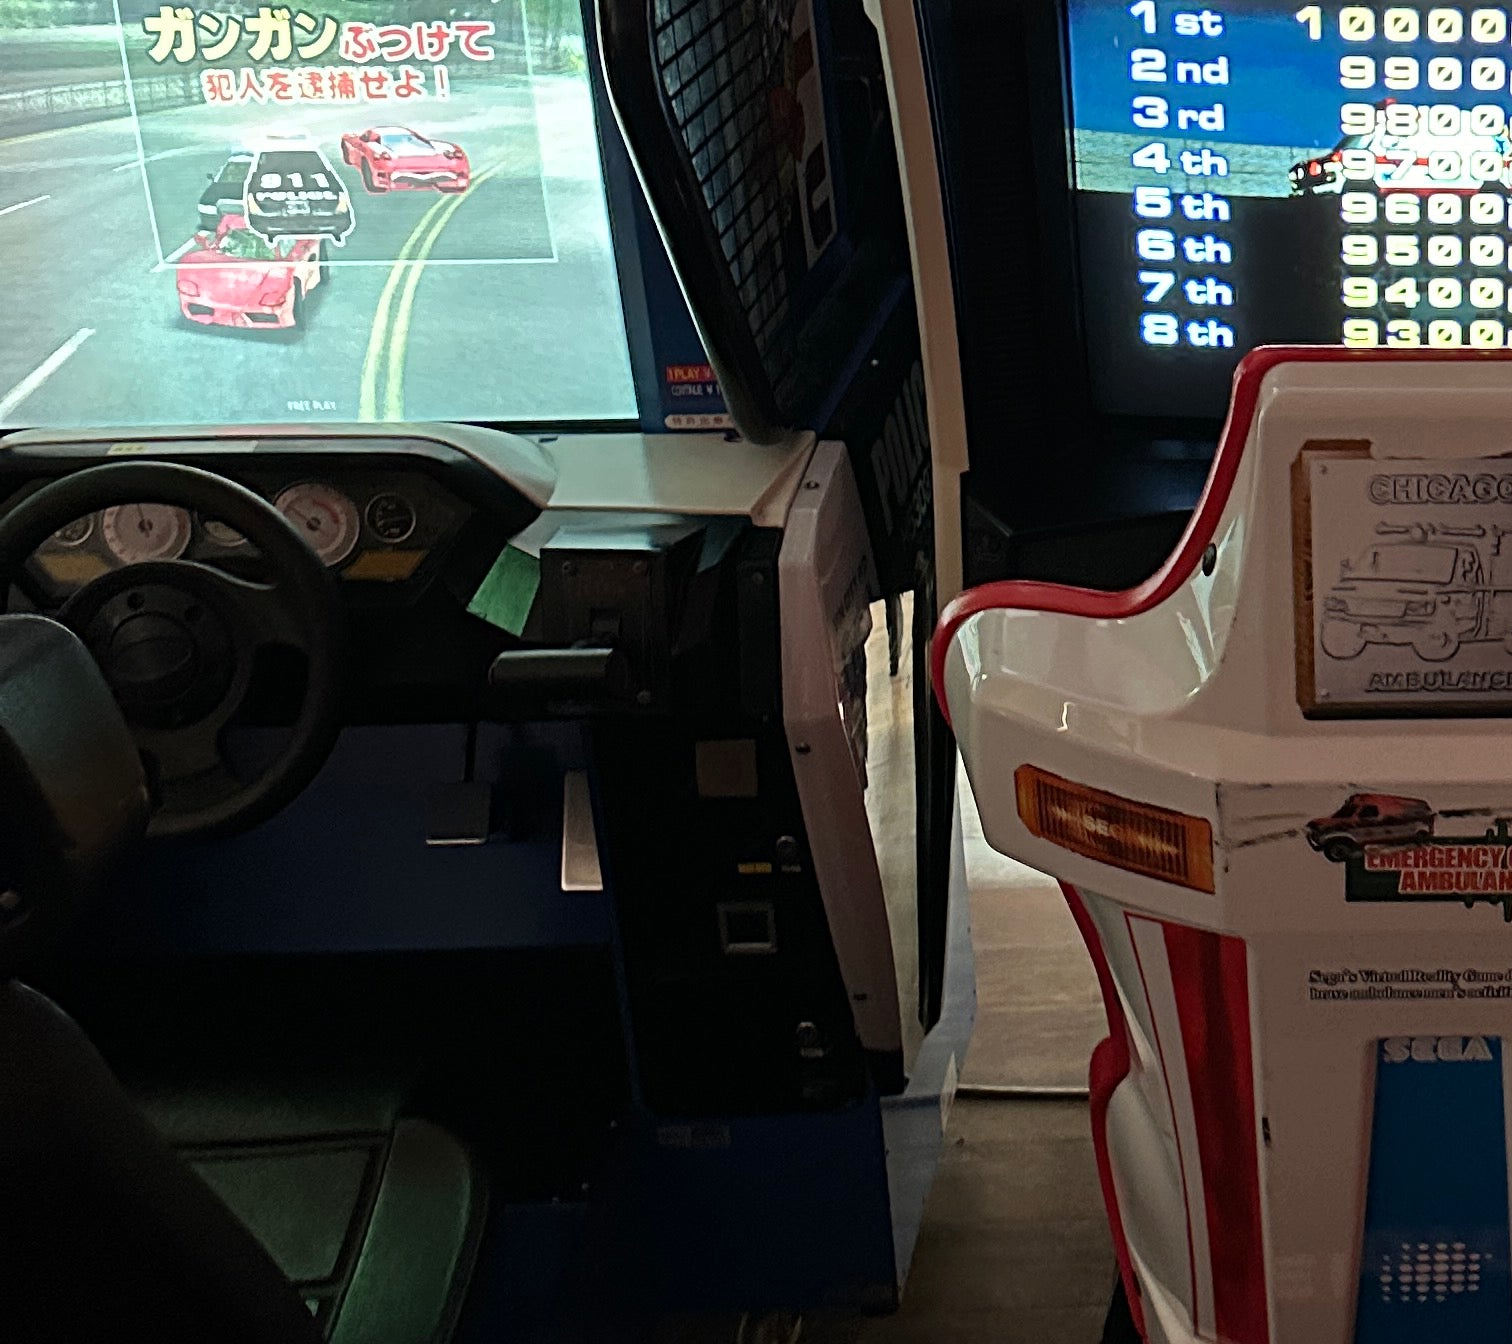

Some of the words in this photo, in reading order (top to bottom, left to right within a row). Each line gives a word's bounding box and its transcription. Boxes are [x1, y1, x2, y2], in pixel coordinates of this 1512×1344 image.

[260, 172, 330, 189] 911
[1366, 846, 1504, 869] EMERGENCY
[1384, 1036, 1493, 1063] SEGA
